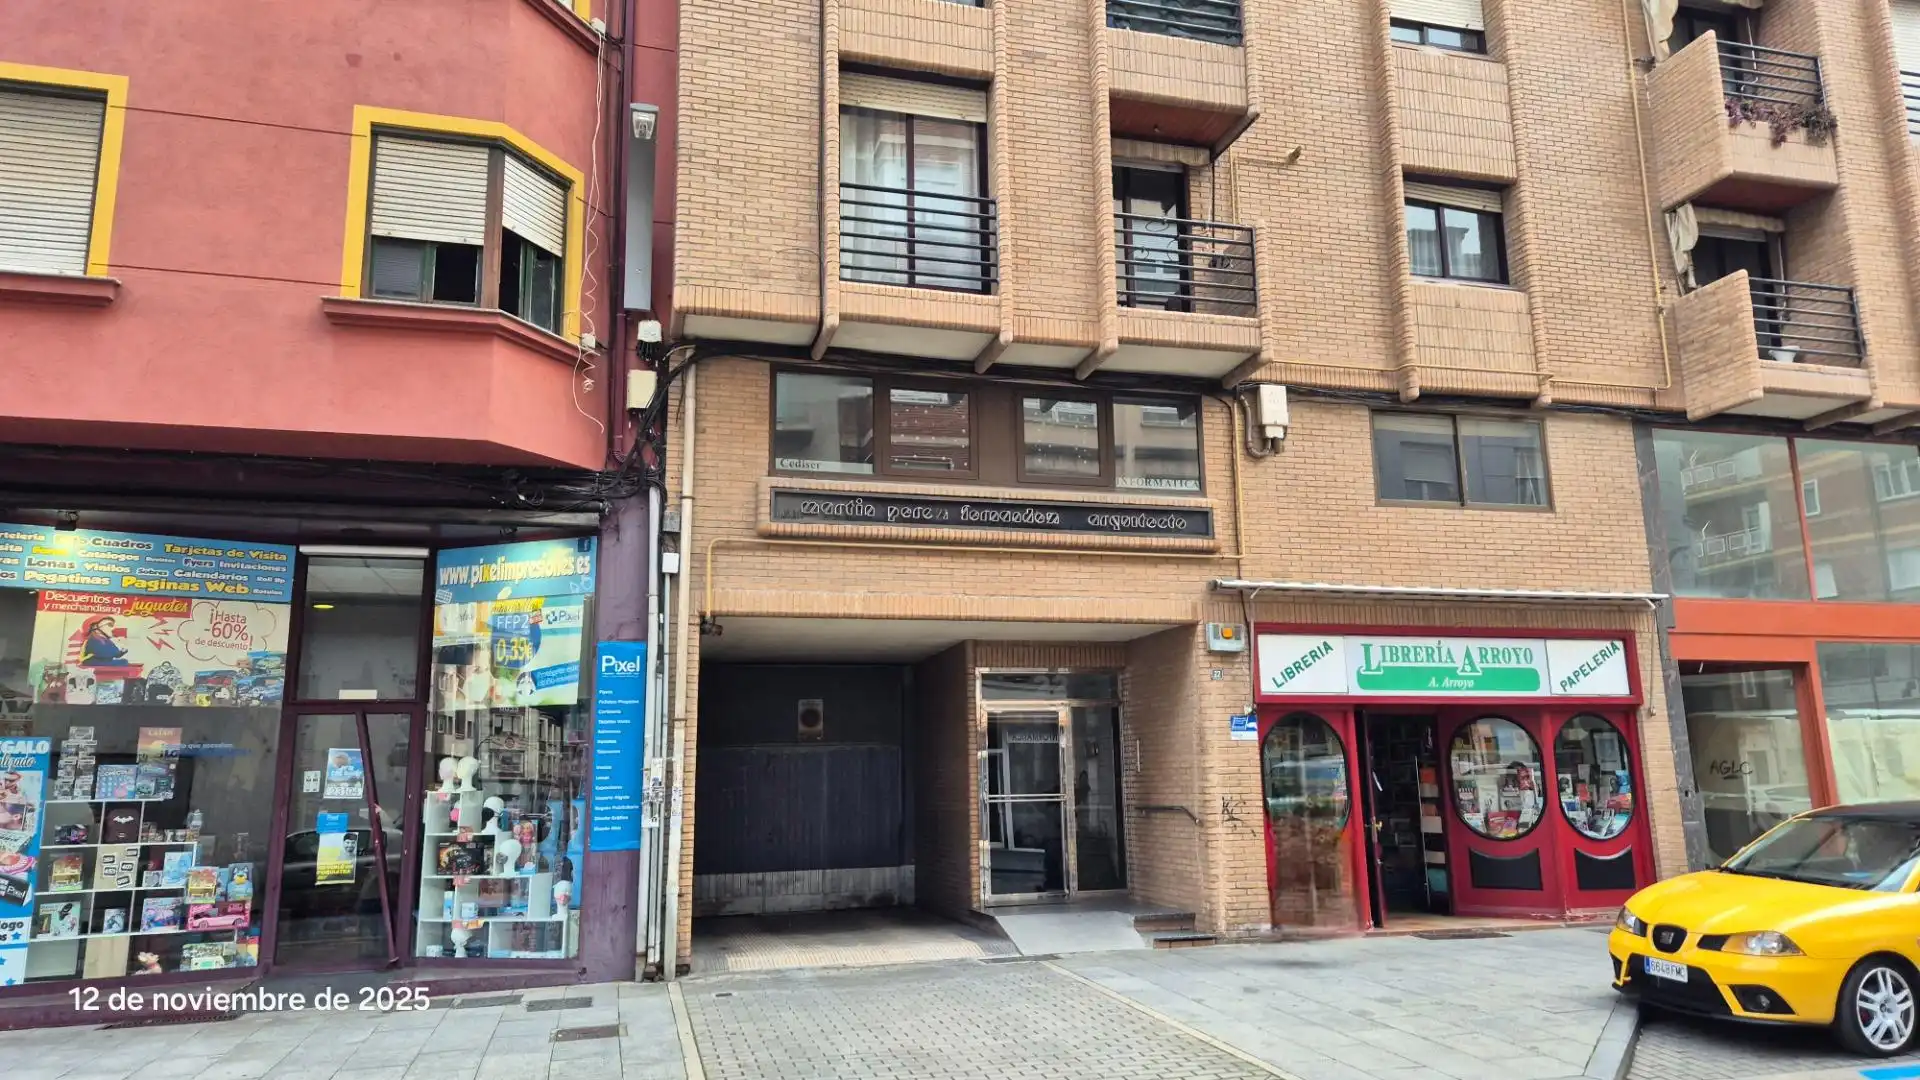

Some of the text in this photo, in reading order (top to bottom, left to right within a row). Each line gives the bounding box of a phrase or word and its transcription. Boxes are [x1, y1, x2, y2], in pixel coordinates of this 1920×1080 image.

[1087, 512, 1187, 530] arquitecto
[92, 537, 153, 550] Cuadros
[164, 543, 223, 557] Tarjetas
[227, 549, 244, 557] de
[248, 550, 287, 560] Visita
[27, 557, 76, 569] Lonas
[174, 569, 249, 581] Calendarios
[219, 561, 287, 572] Invitaciones
[24, 570, 110, 585] Pegatinas
[121, 575, 200, 592] Paginas
[205, 580, 249, 594] Web
[43, 602, 121, 615] y merchandising
[44, 590, 189, 618] Descuentos en juguetes
[497, 614, 529, 629] FFP2
[204, 621, 249, 641] -60%
[195, 638, 206, 646] de
[601, 655, 641, 672] Pixel
[1271, 640, 1335, 689] LIBRERIA
[1360, 640, 1534, 673] LIBRERÍA ARROYO
[1559, 640, 1621, 692] PAPELERIA
[1428, 677, 1475, 689] A. Arroyo
[0, 740, 49, 754] GALO
[7, 885, 26, 900] Pixel
